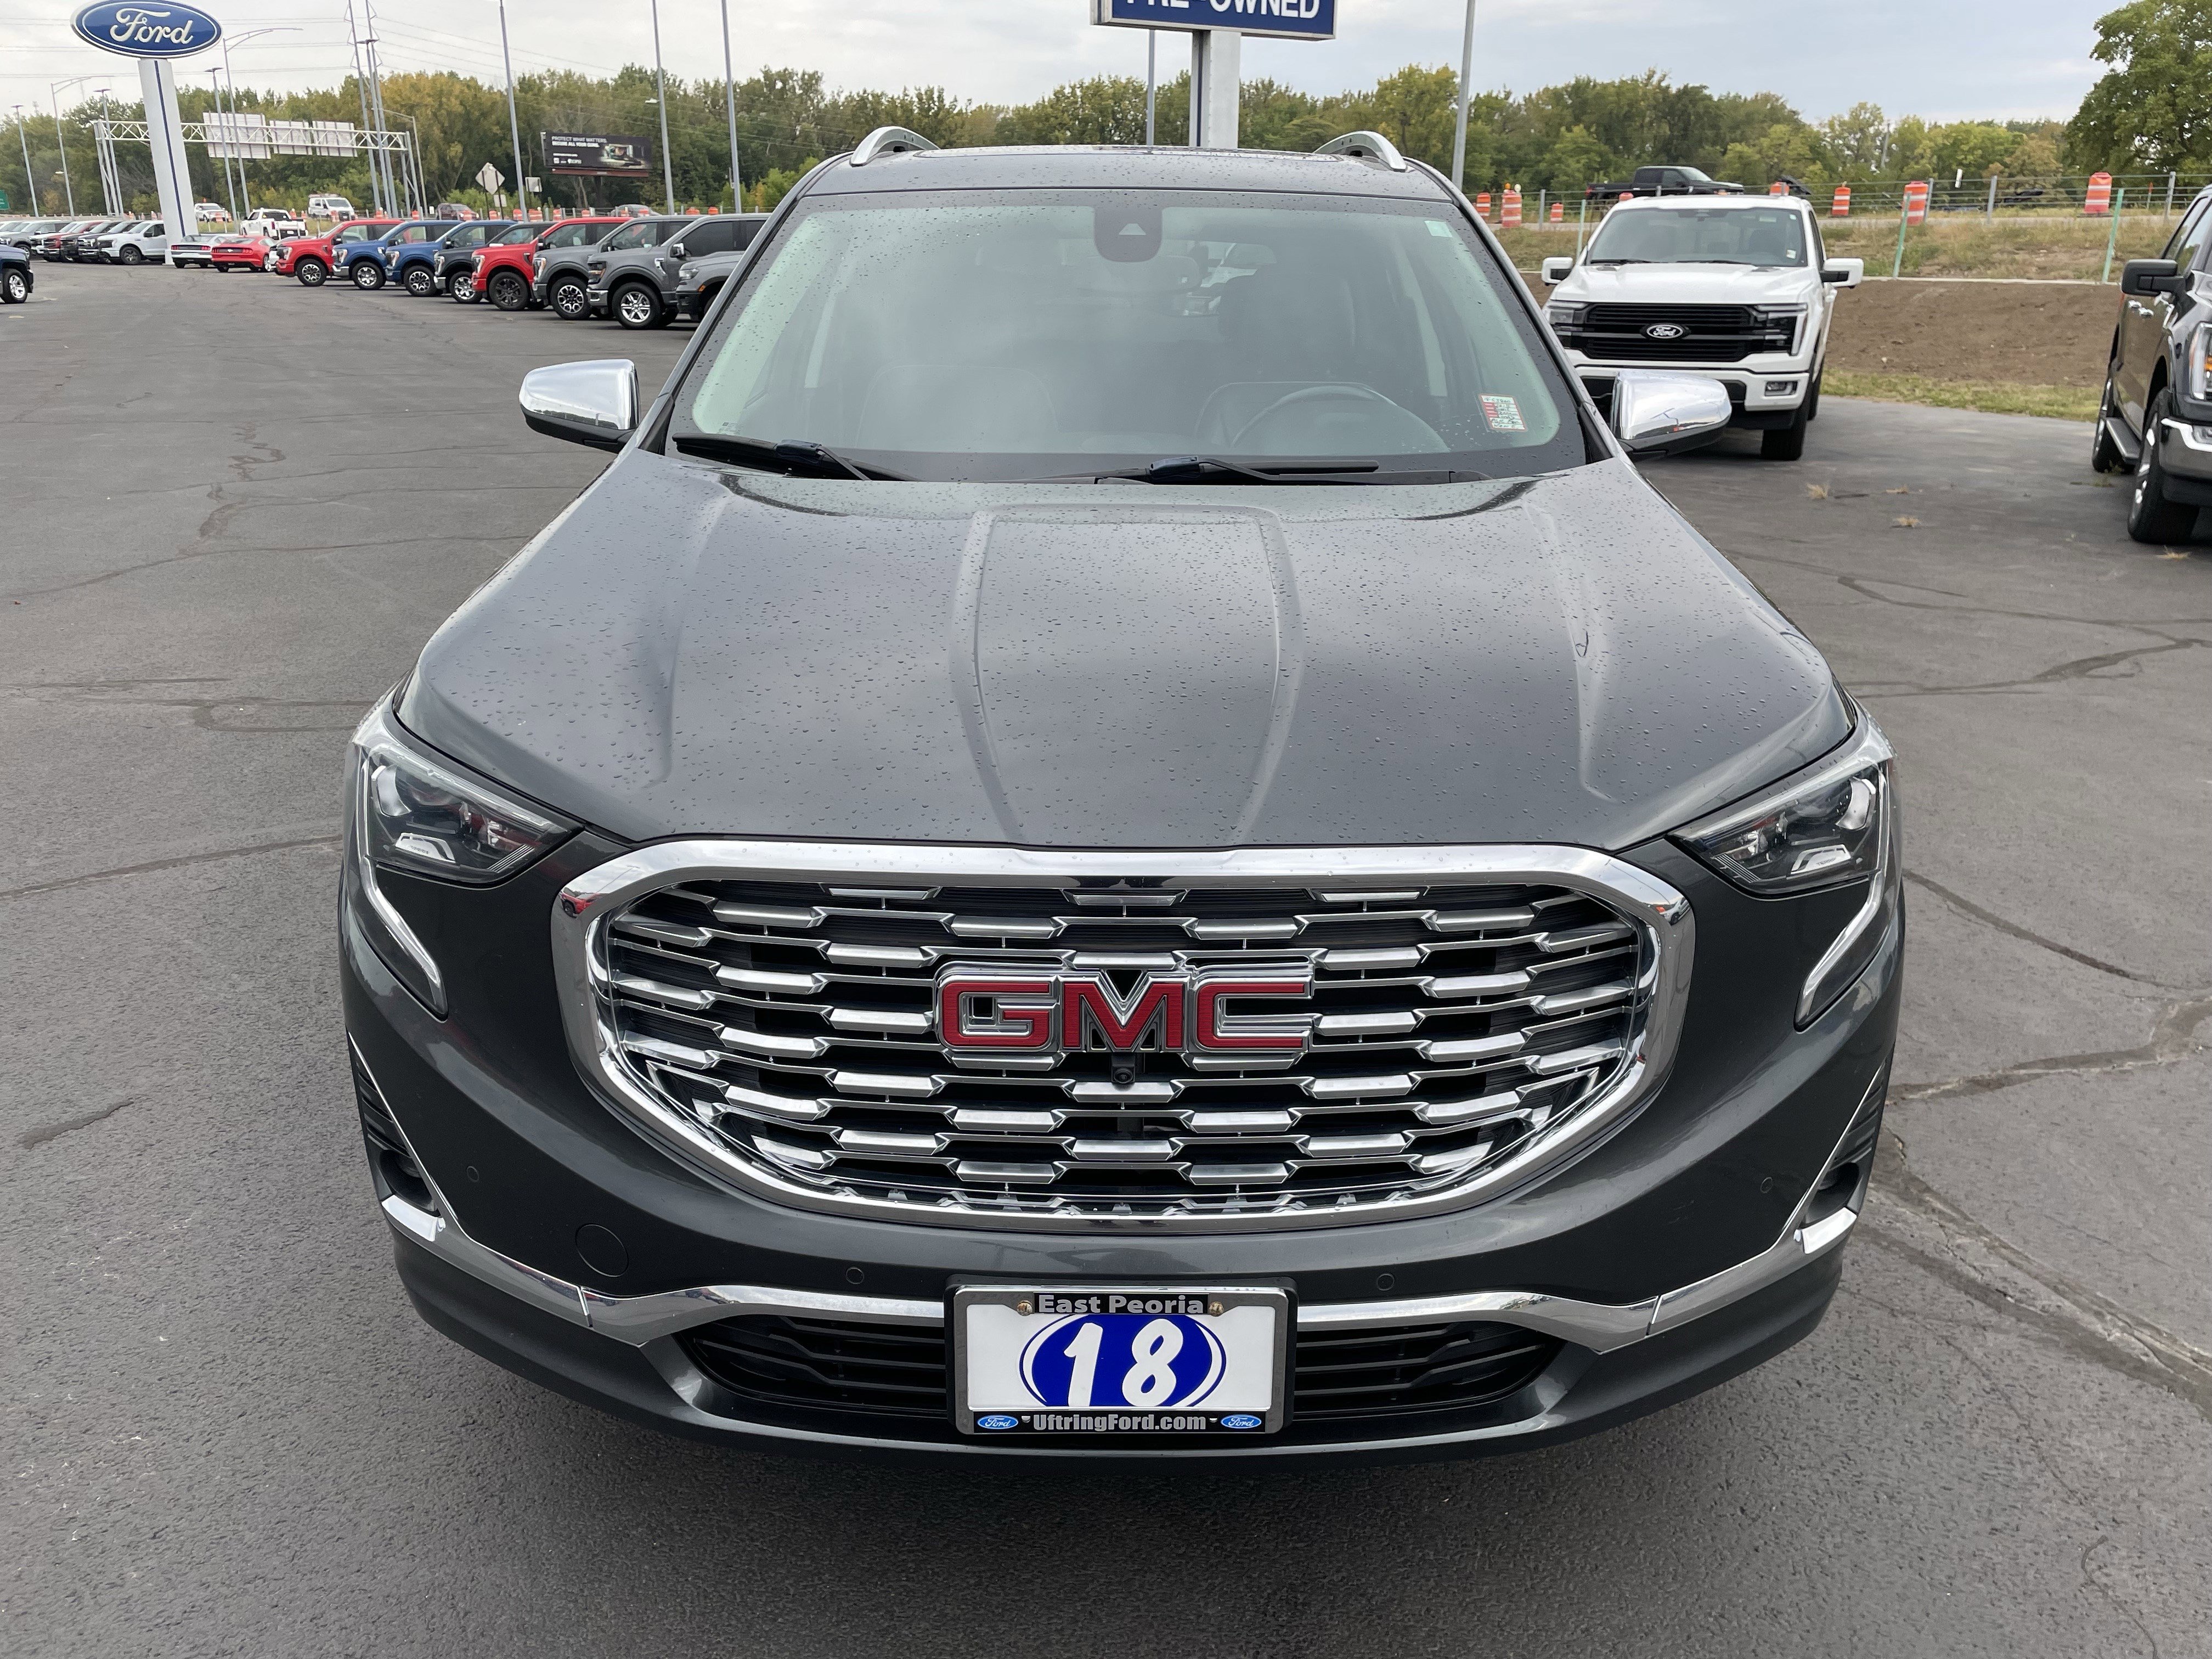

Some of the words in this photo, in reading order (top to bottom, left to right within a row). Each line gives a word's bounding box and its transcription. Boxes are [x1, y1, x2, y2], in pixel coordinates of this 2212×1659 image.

[110, 8, 194, 44] Ford
[1653, 326, 1676, 336] Ford
[937, 978, 1311, 1052] GMC
[1037, 1295, 1100, 1314] East
[1109, 1295, 1204, 1314] Peoria
[1064, 1318, 1183, 1407] 18
[985, 1417, 1011, 1427] Ford
[1034, 1414, 1206, 1432] UftringFord.com
[1228, 1417, 1254, 1427] Ford
